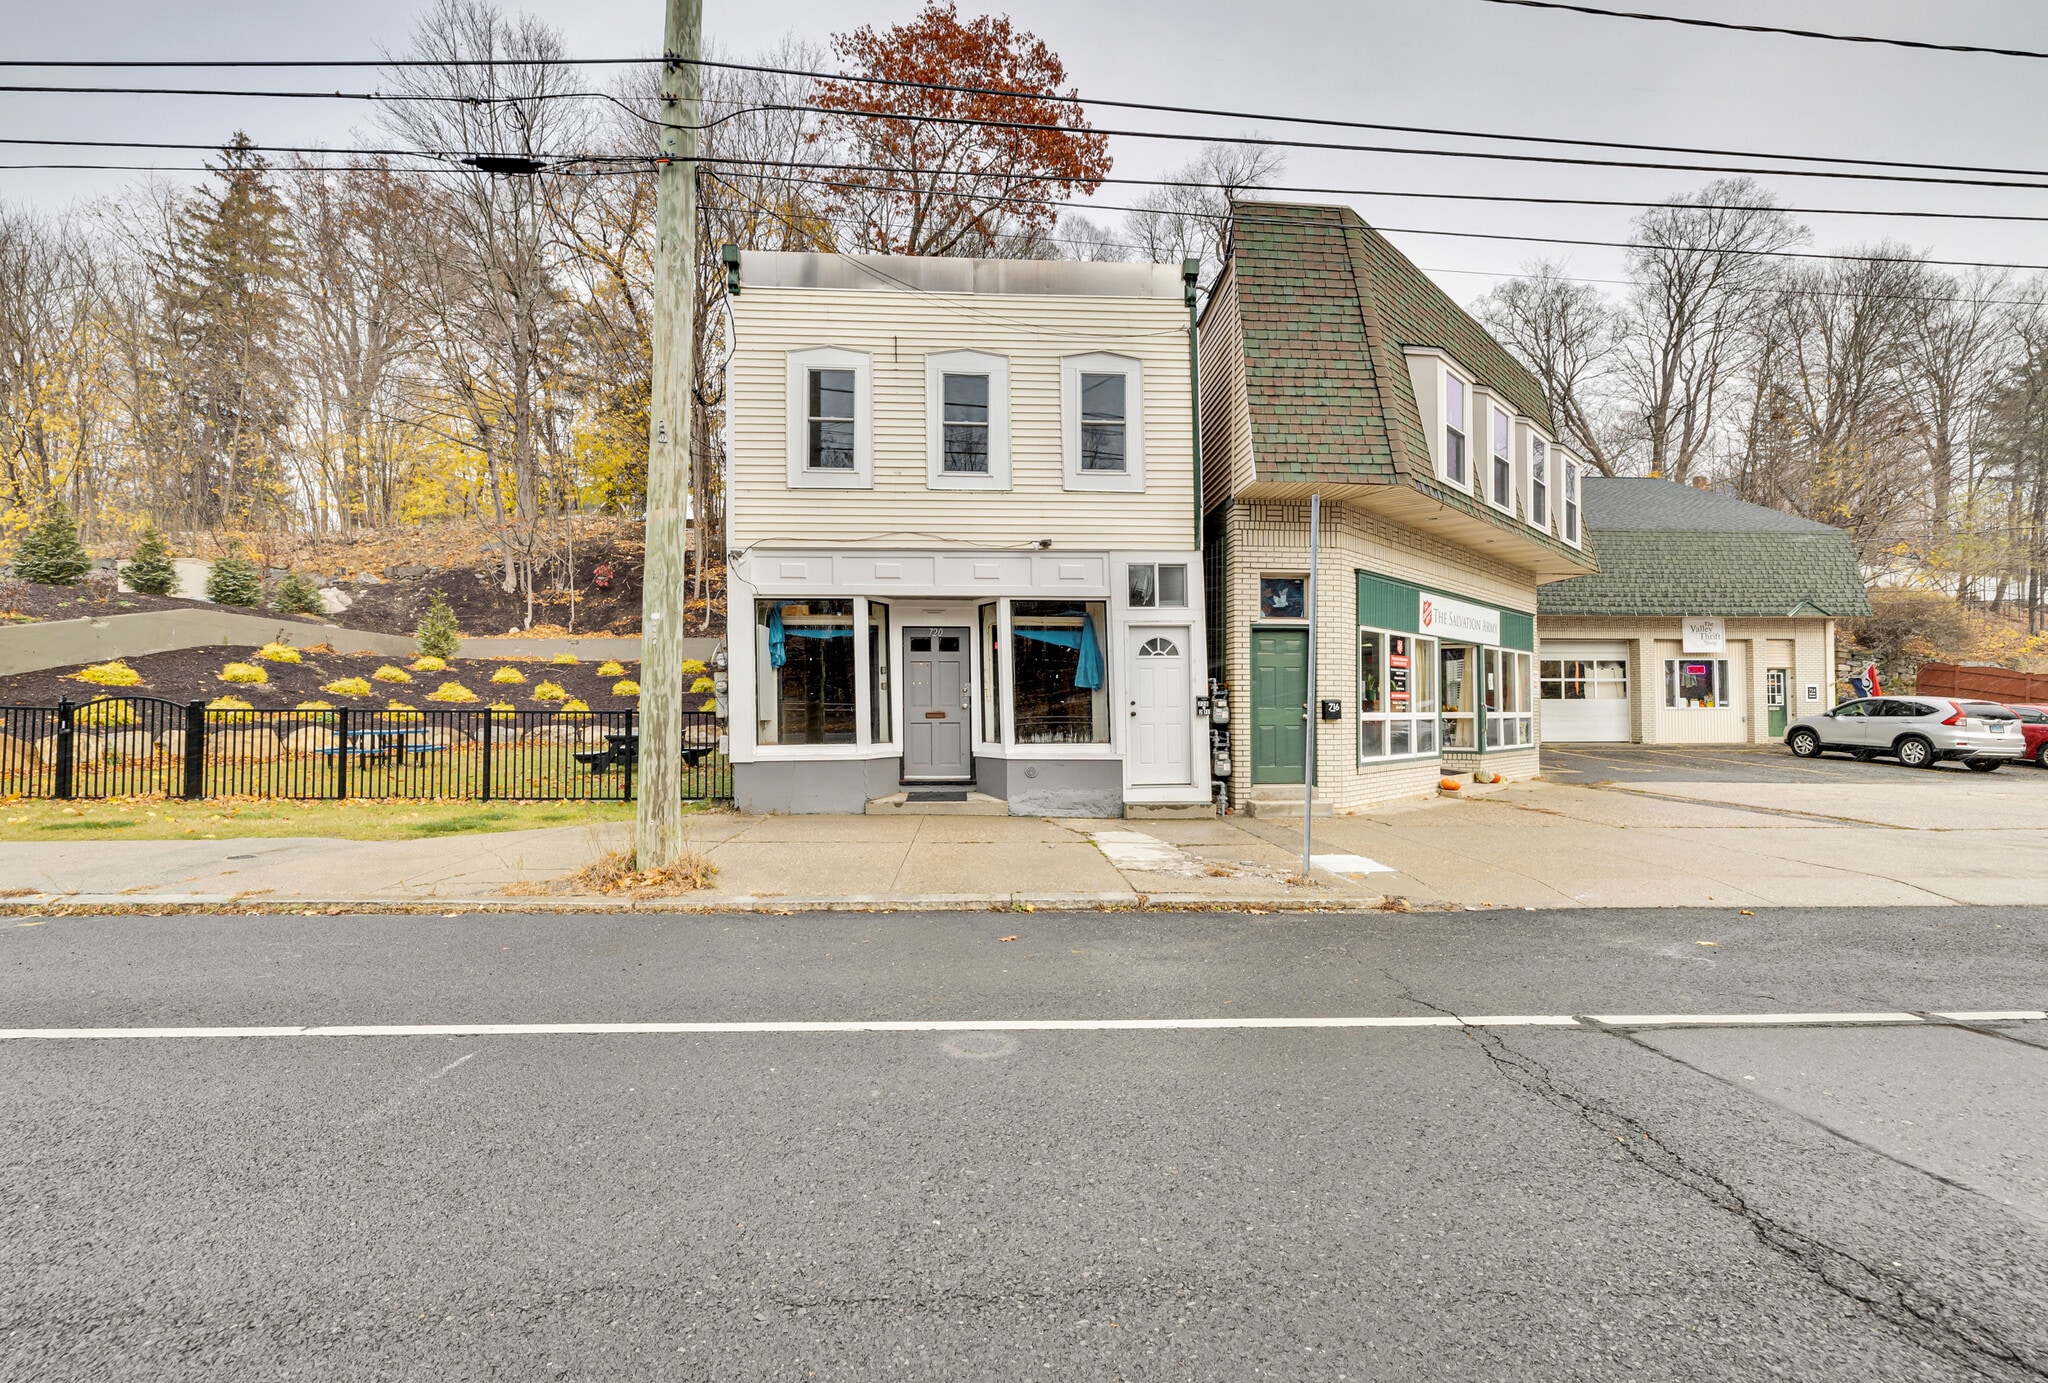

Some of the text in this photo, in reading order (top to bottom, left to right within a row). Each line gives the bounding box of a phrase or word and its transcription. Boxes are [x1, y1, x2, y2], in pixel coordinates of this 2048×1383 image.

[1449, 611, 1480, 631] SALVATION
[929, 628, 943, 637] 720
[1690, 625, 1712, 633] Valley
[1700, 632, 1720, 640] Thrift
